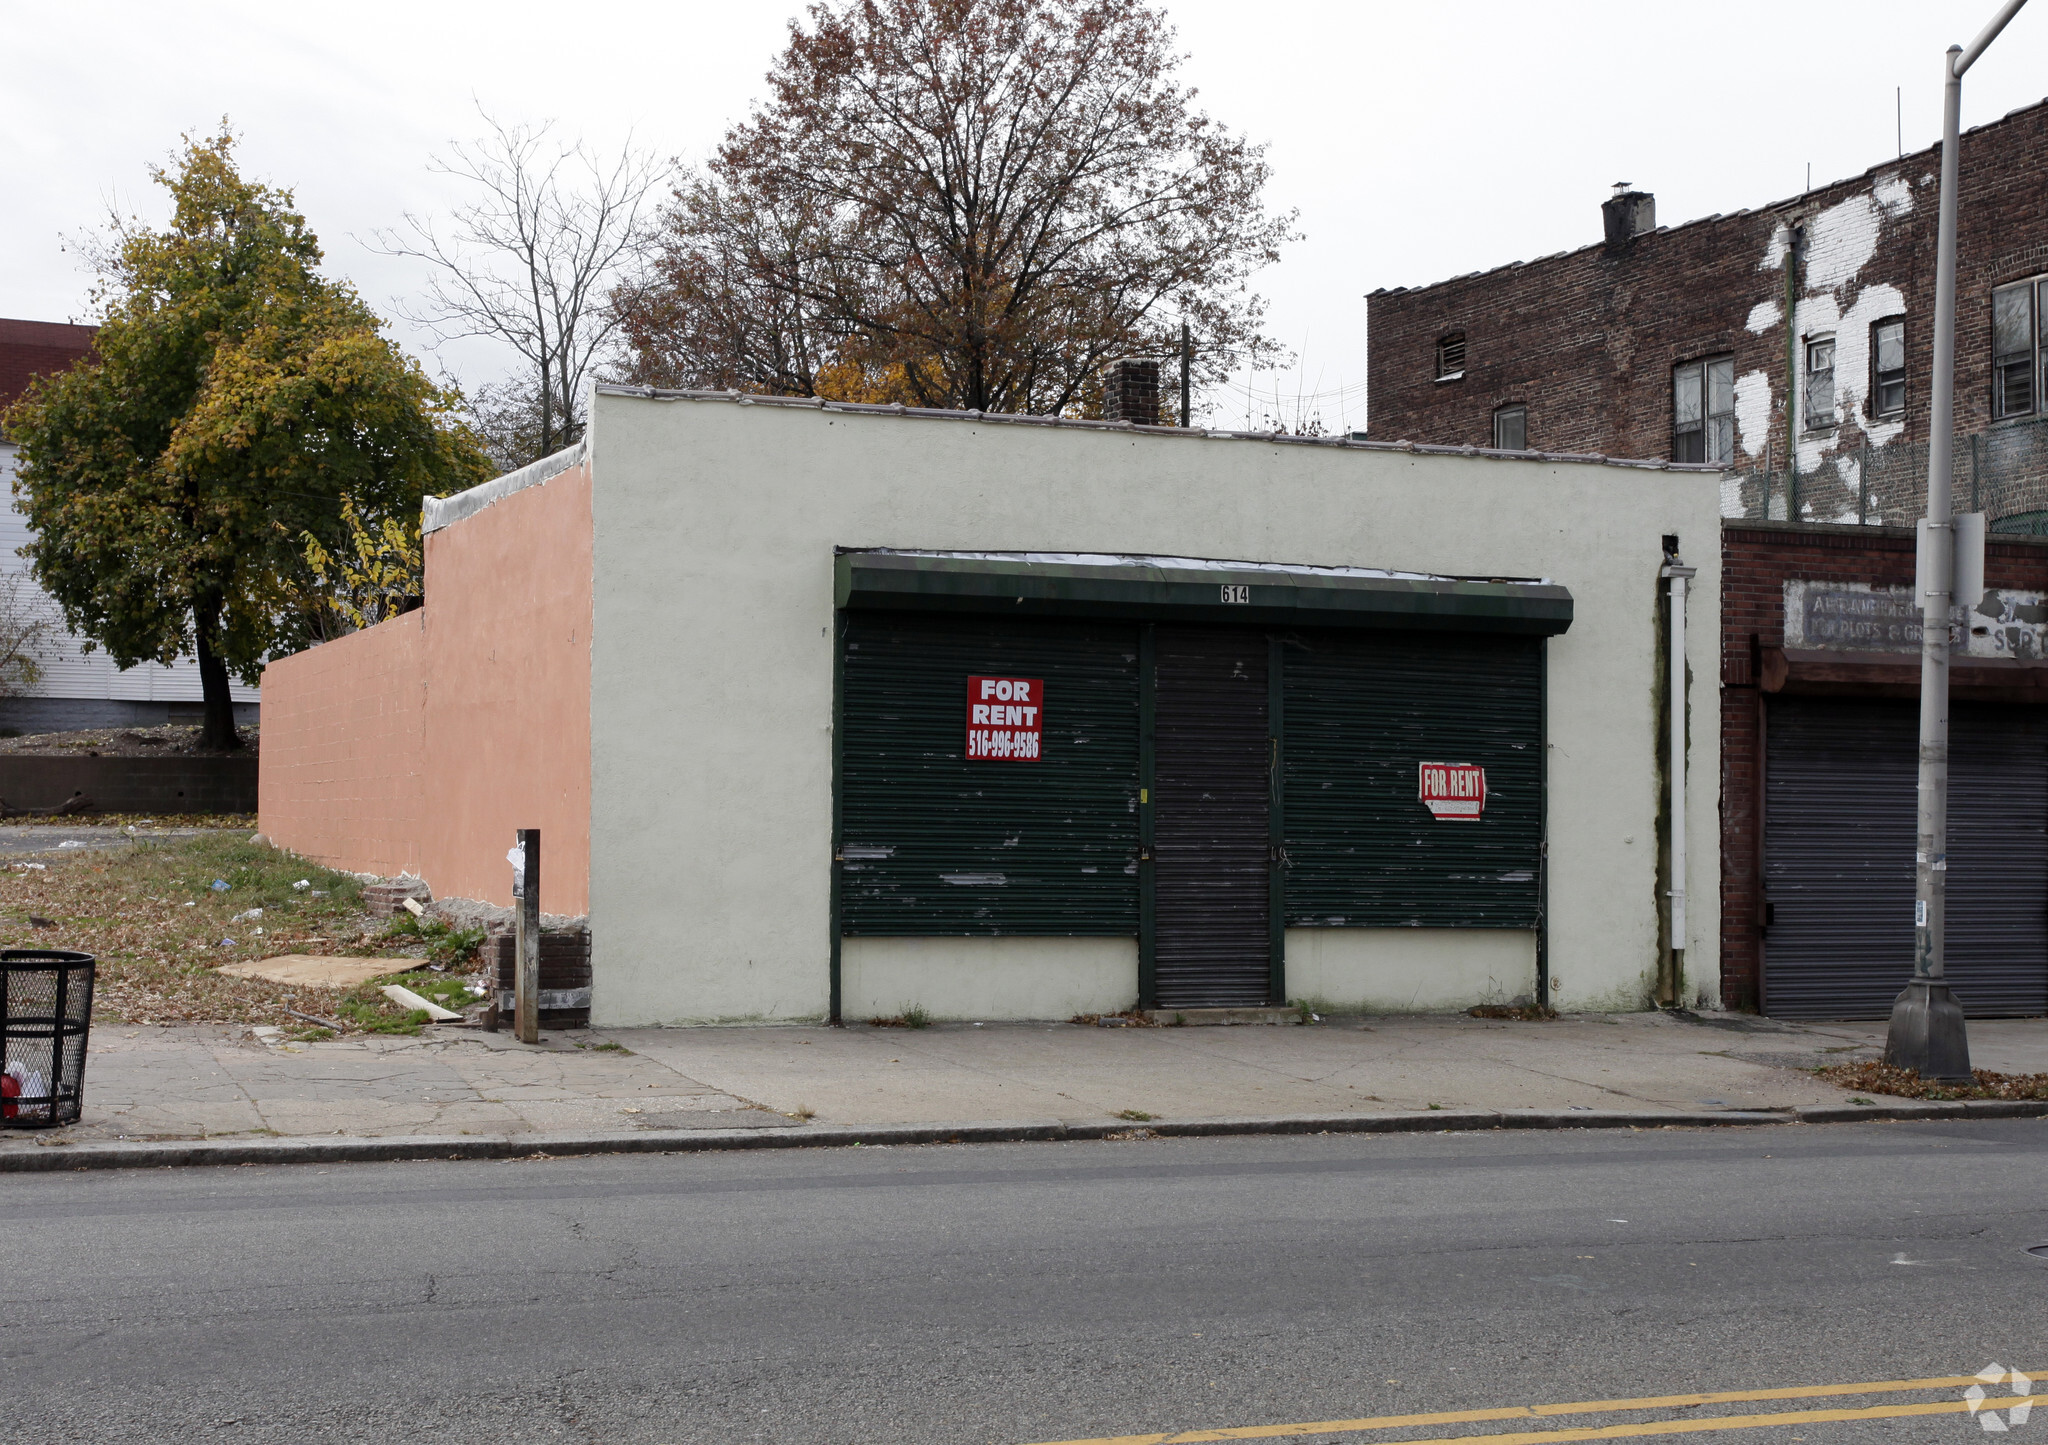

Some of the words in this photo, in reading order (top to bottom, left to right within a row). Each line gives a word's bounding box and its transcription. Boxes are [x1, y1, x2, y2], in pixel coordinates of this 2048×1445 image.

[1223, 585, 1247, 602] 614
[1840, 620, 1881, 641] PLOTS
[981, 680, 1030, 701] FOR
[973, 704, 1037, 726] RENT
[969, 730, 1039, 758] 516-996-9586
[1424, 769, 1446, 796] FOR
[1450, 770, 1480, 797] RENT
